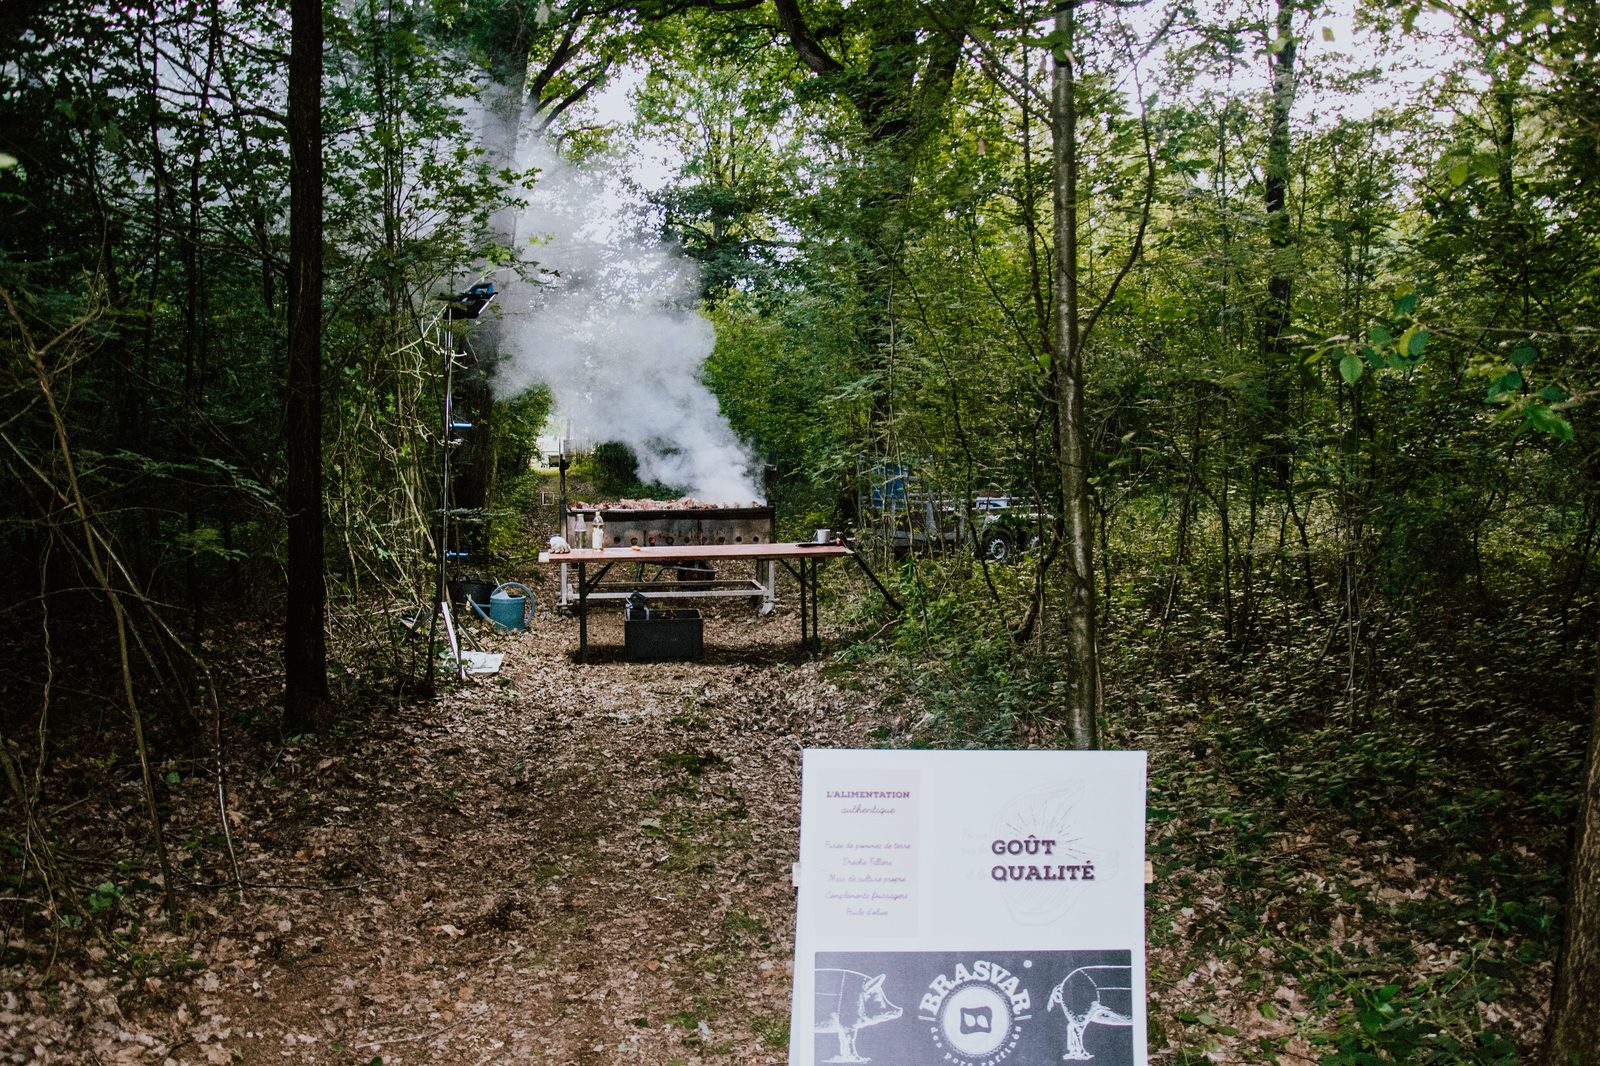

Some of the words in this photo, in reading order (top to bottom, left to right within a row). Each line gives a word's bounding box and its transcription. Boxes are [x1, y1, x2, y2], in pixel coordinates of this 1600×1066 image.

[826, 791, 910, 799] L'ALIMENTATION
[840, 803, 896, 814] authentique
[991, 833, 1057, 856] GOÛT
[990, 859, 1096, 883] QUALITÉ
[919, 960, 1031, 1016] BRASVAR
